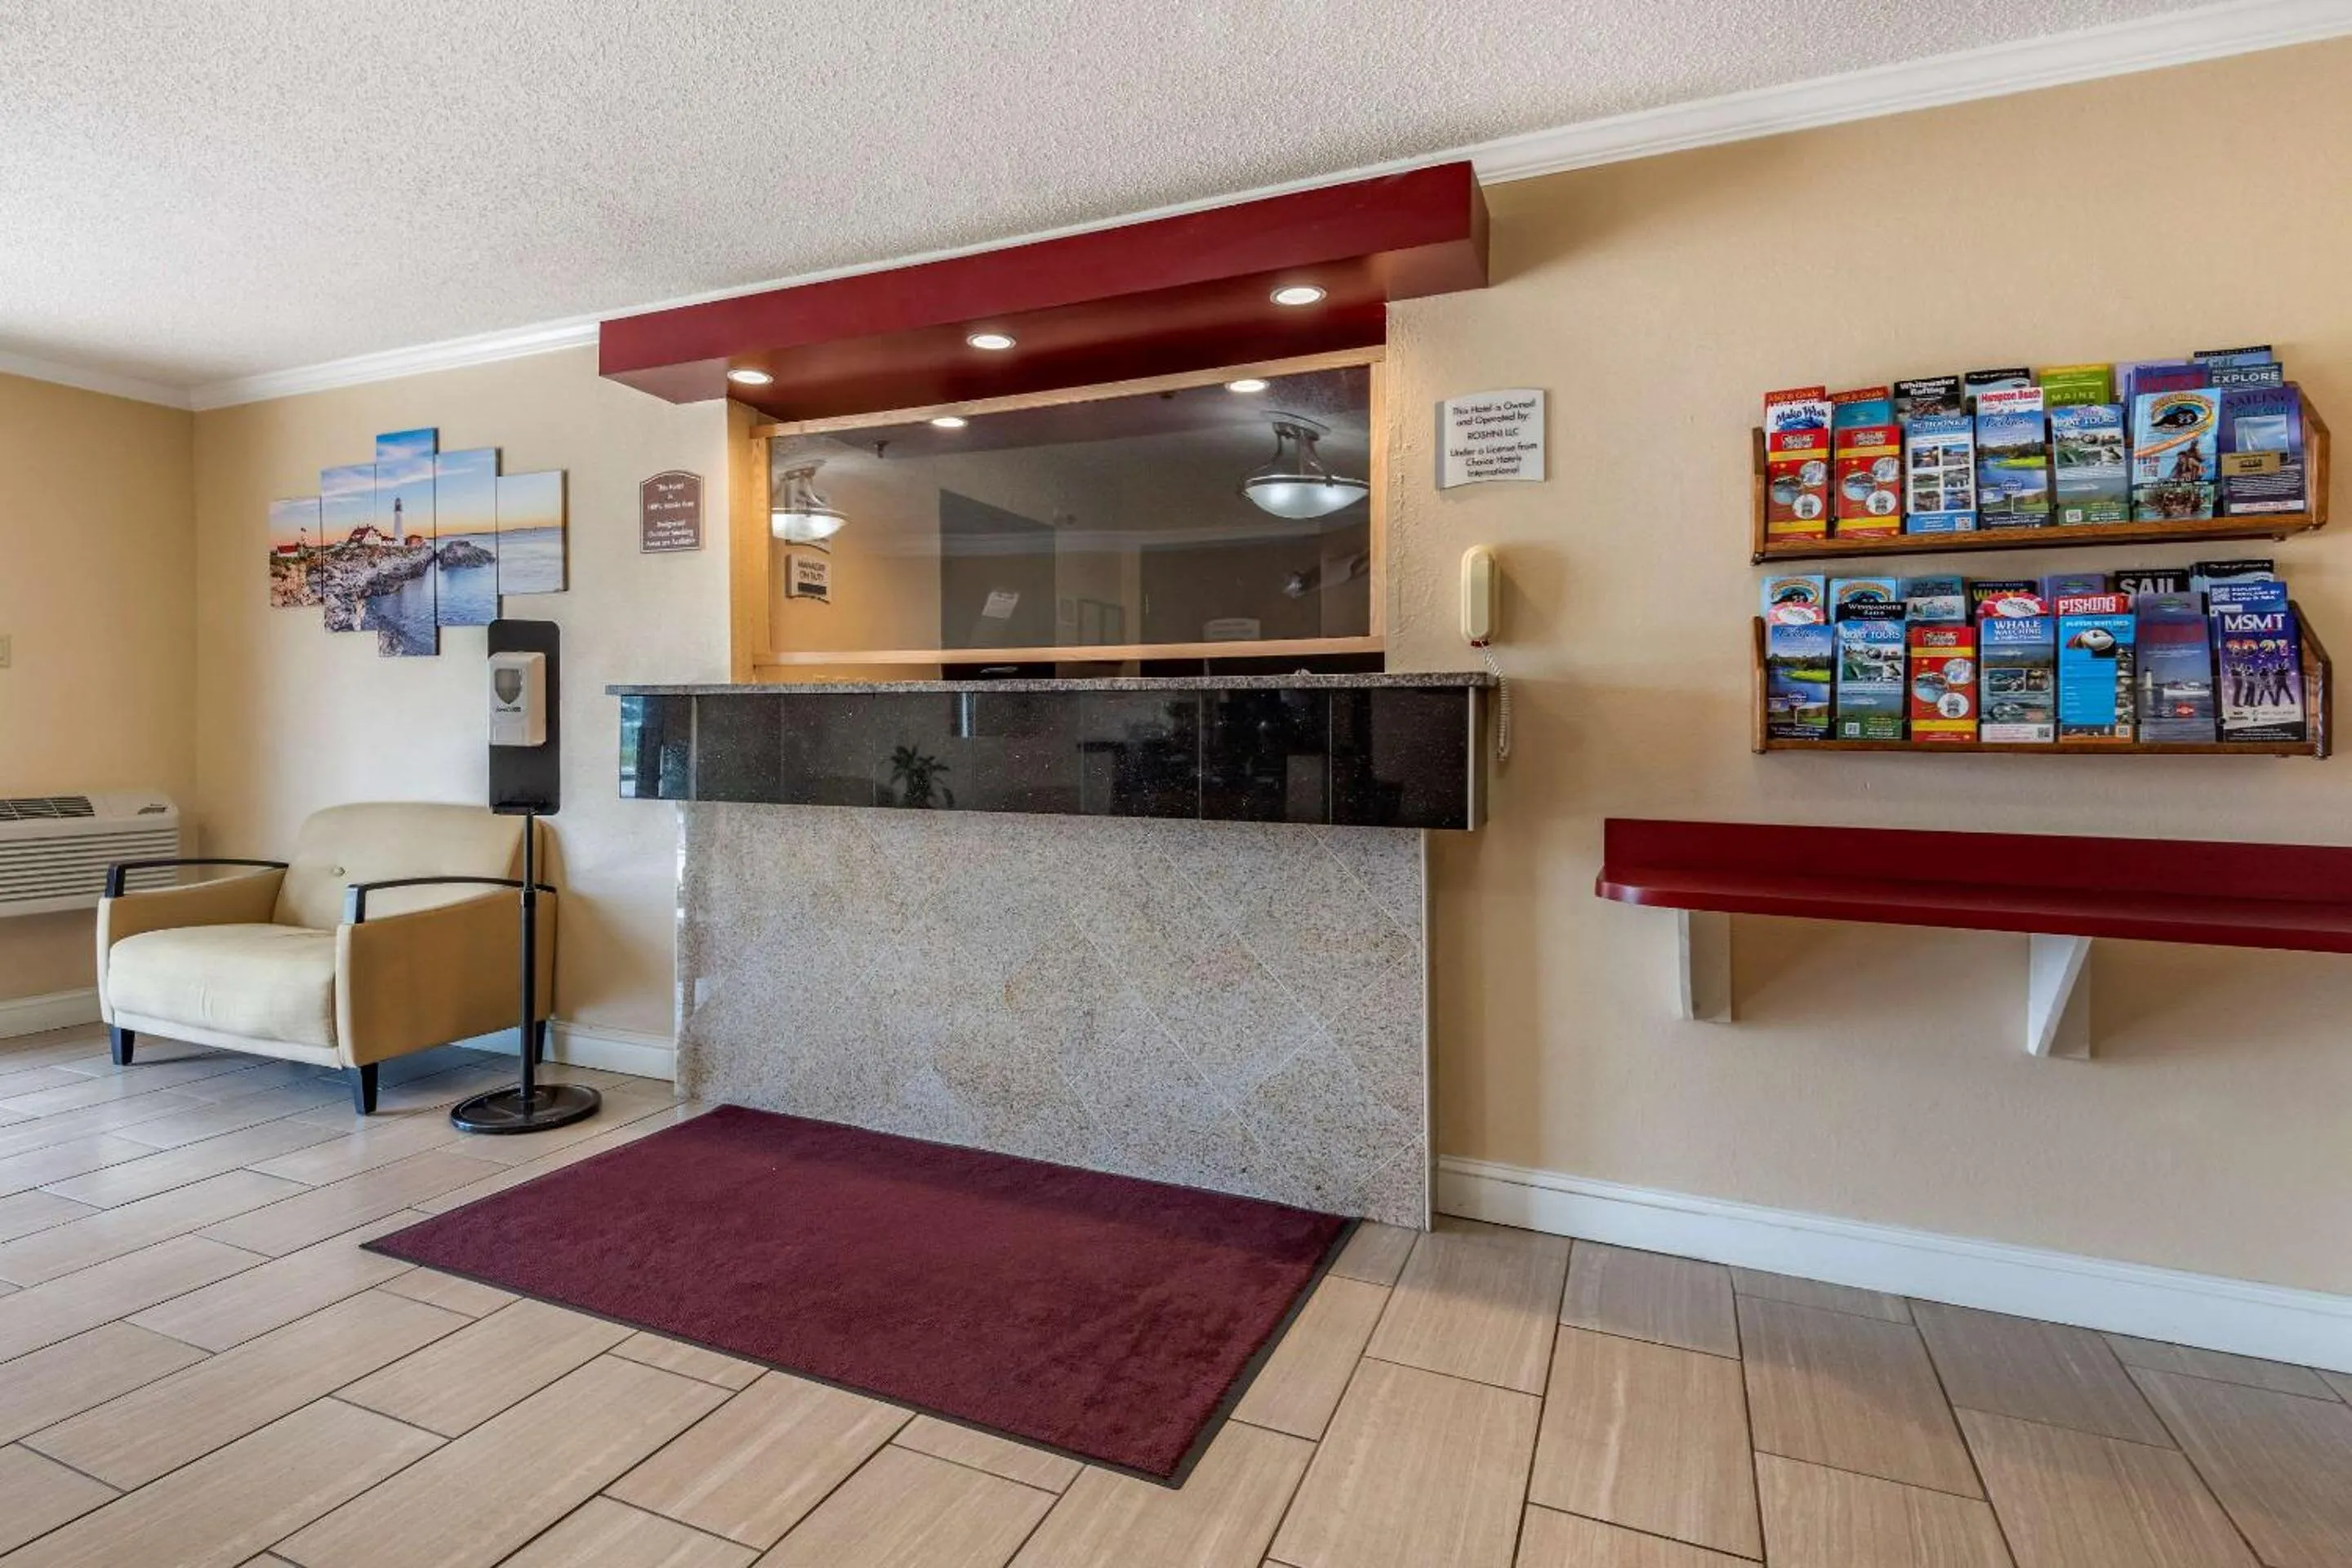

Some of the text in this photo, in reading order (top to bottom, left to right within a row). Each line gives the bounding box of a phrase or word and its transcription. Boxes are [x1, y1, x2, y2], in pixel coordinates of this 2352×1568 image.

[2212, 371, 2279, 384] EXPLORE
[1900, 378, 1957, 390] Whitewater
[1909, 386, 1947, 396] Rafting
[1981, 389, 2041, 403] Hampton Beach
[2051, 391, 2096, 401] MAINE
[1453, 407, 1468, 415] This
[1471, 403, 1492, 413] Hotel
[1503, 398, 1536, 410] Owned
[1456, 417, 1472, 426] and
[1475, 413, 1516, 425] Operated
[2083, 414, 2117, 425] TOURS
[1467, 428, 1520, 440] ROSHNI LLC
[1450, 448, 1475, 457] Under
[1486, 444, 1515, 454] License
[1517, 442, 1537, 450] from
[1465, 457, 1494, 466] Choice
[798, 559, 826, 572] MANAGER
[2058, 596, 2116, 614] FISHING
[1993, 620, 2042, 630] WHALE
[2224, 614, 2285, 632] MSMT
[1871, 630, 1901, 639] TOURS
[1993, 628, 2042, 636] WATCHING
